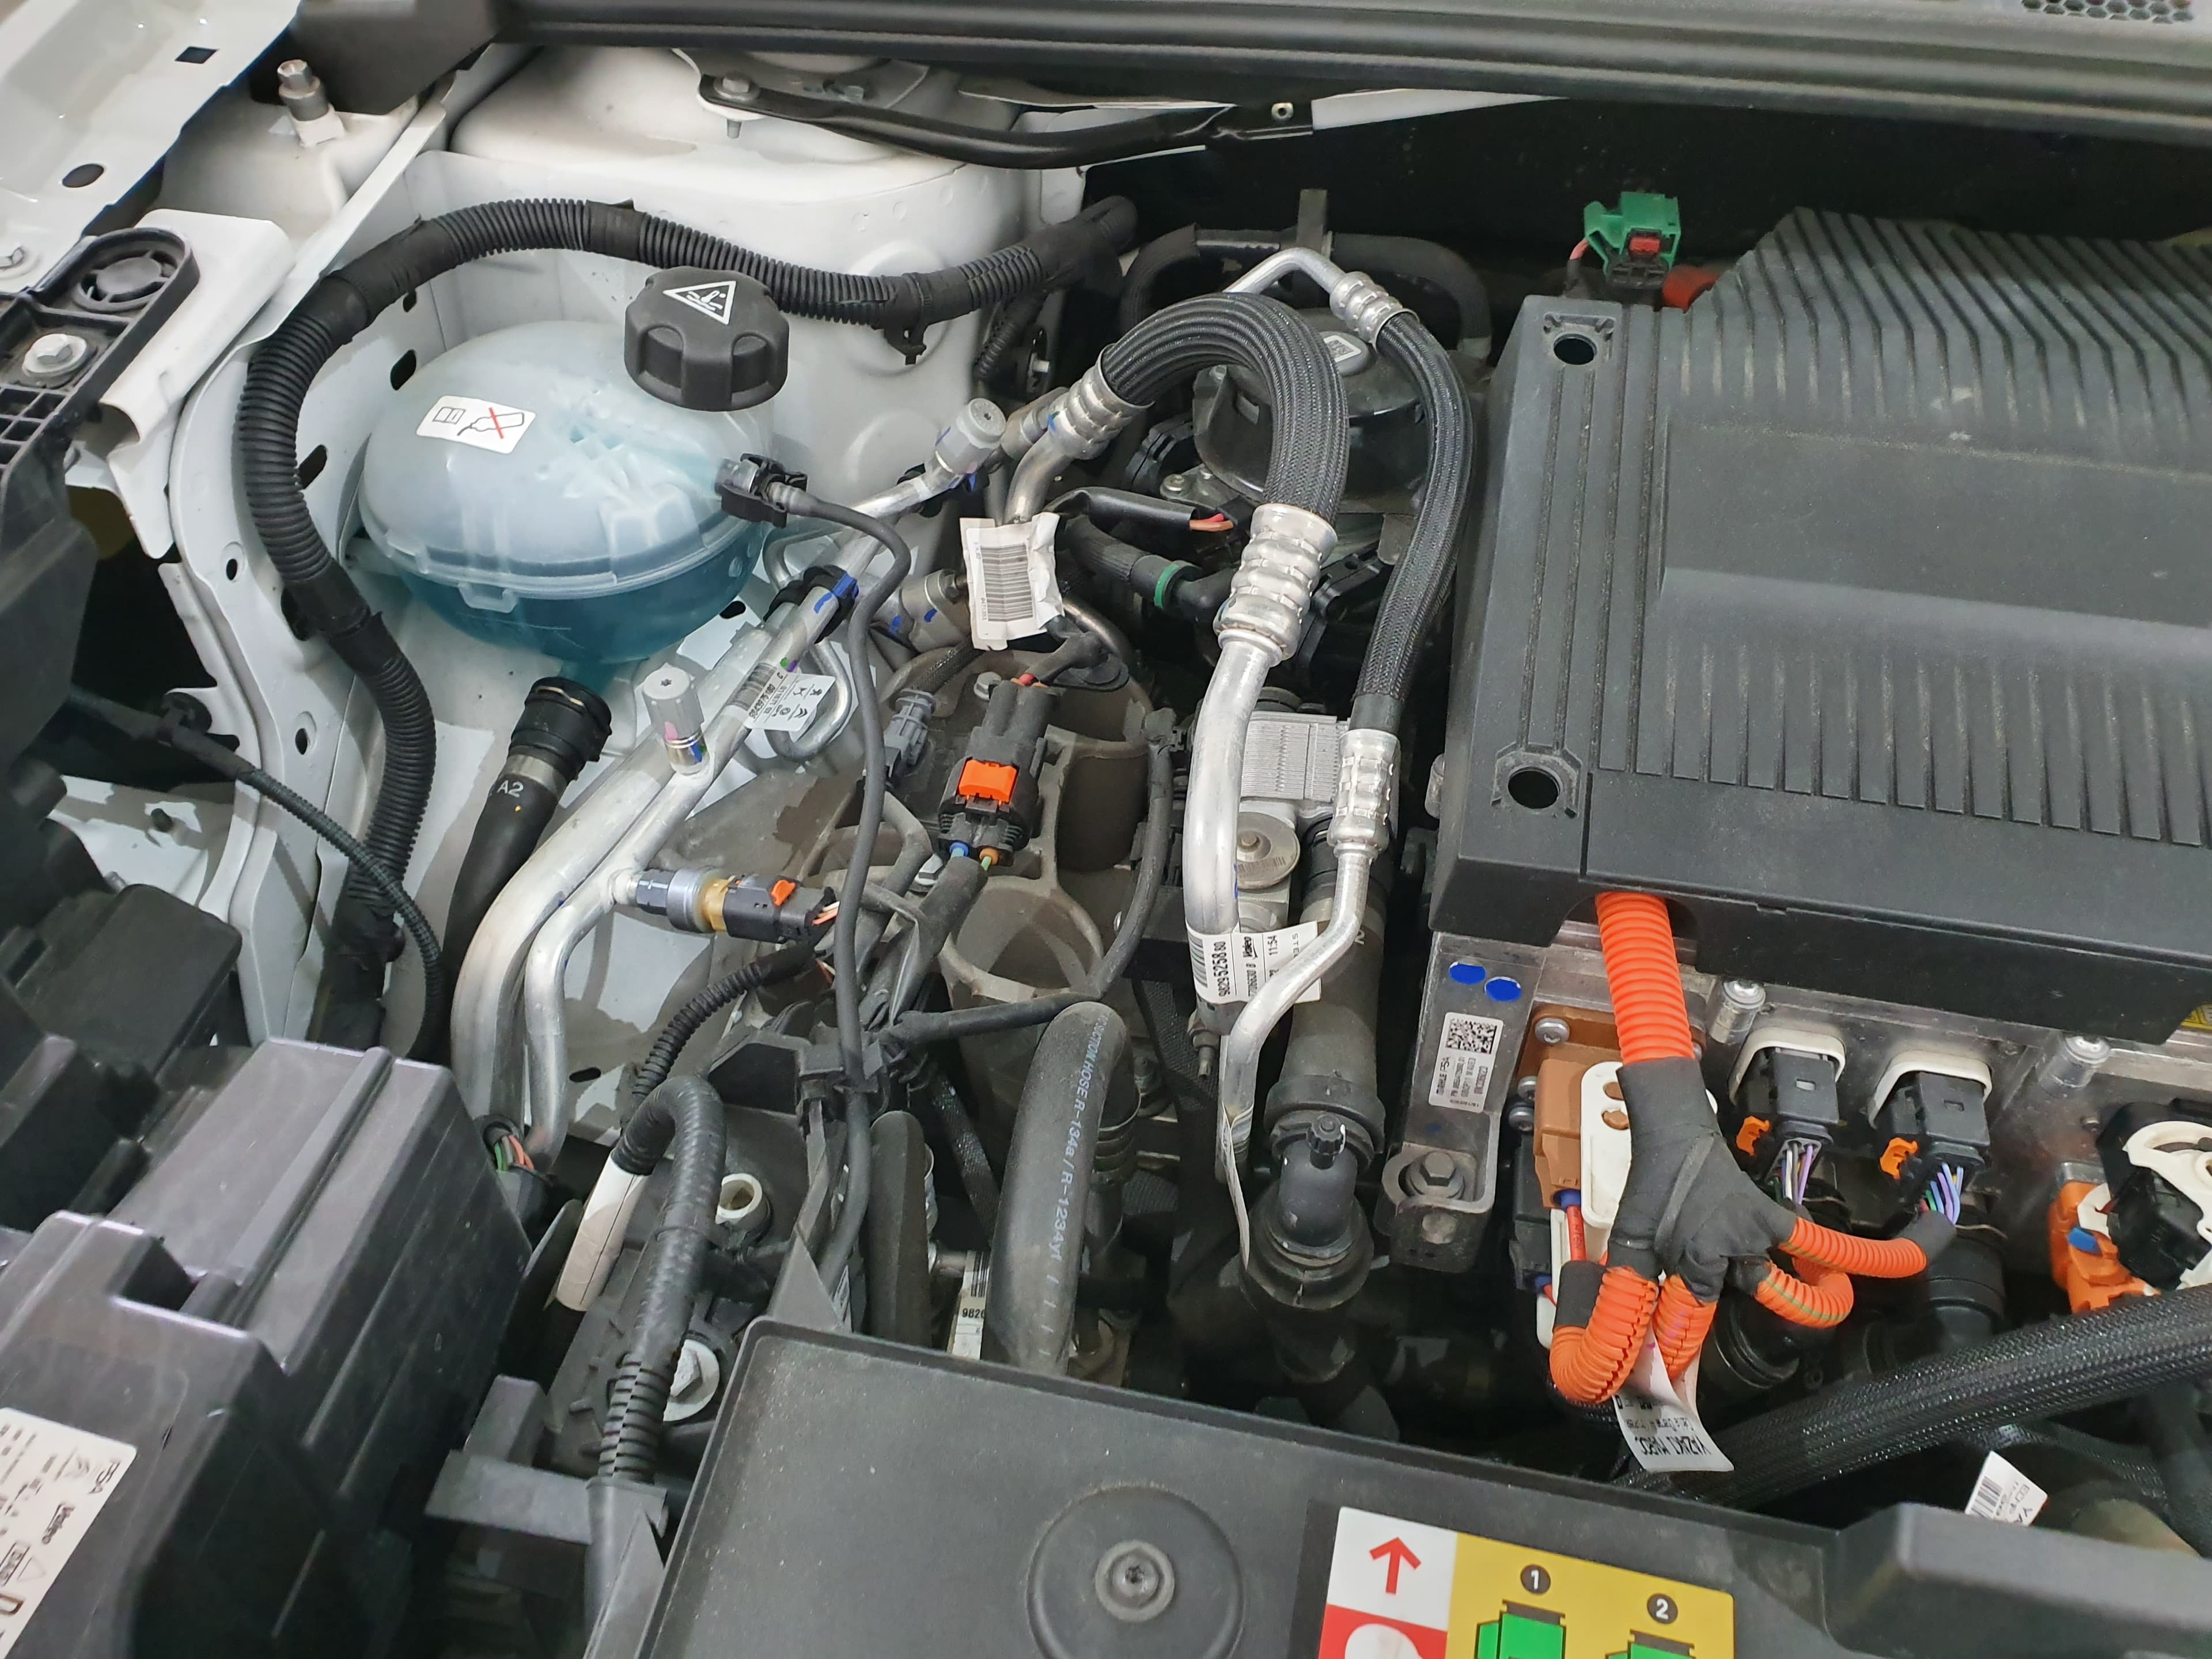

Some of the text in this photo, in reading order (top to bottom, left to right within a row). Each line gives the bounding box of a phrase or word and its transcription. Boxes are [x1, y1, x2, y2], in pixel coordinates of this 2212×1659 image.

[496, 779, 524, 798] A2
[1077, 1060, 1094, 1097] HOSE
[1063, 1098, 1085, 1156] R-134a
[1048, 1171, 1074, 1261] R-1234yf
[1531, 1569, 1539, 1590] 1
[1655, 1598, 1669, 1620] 2
